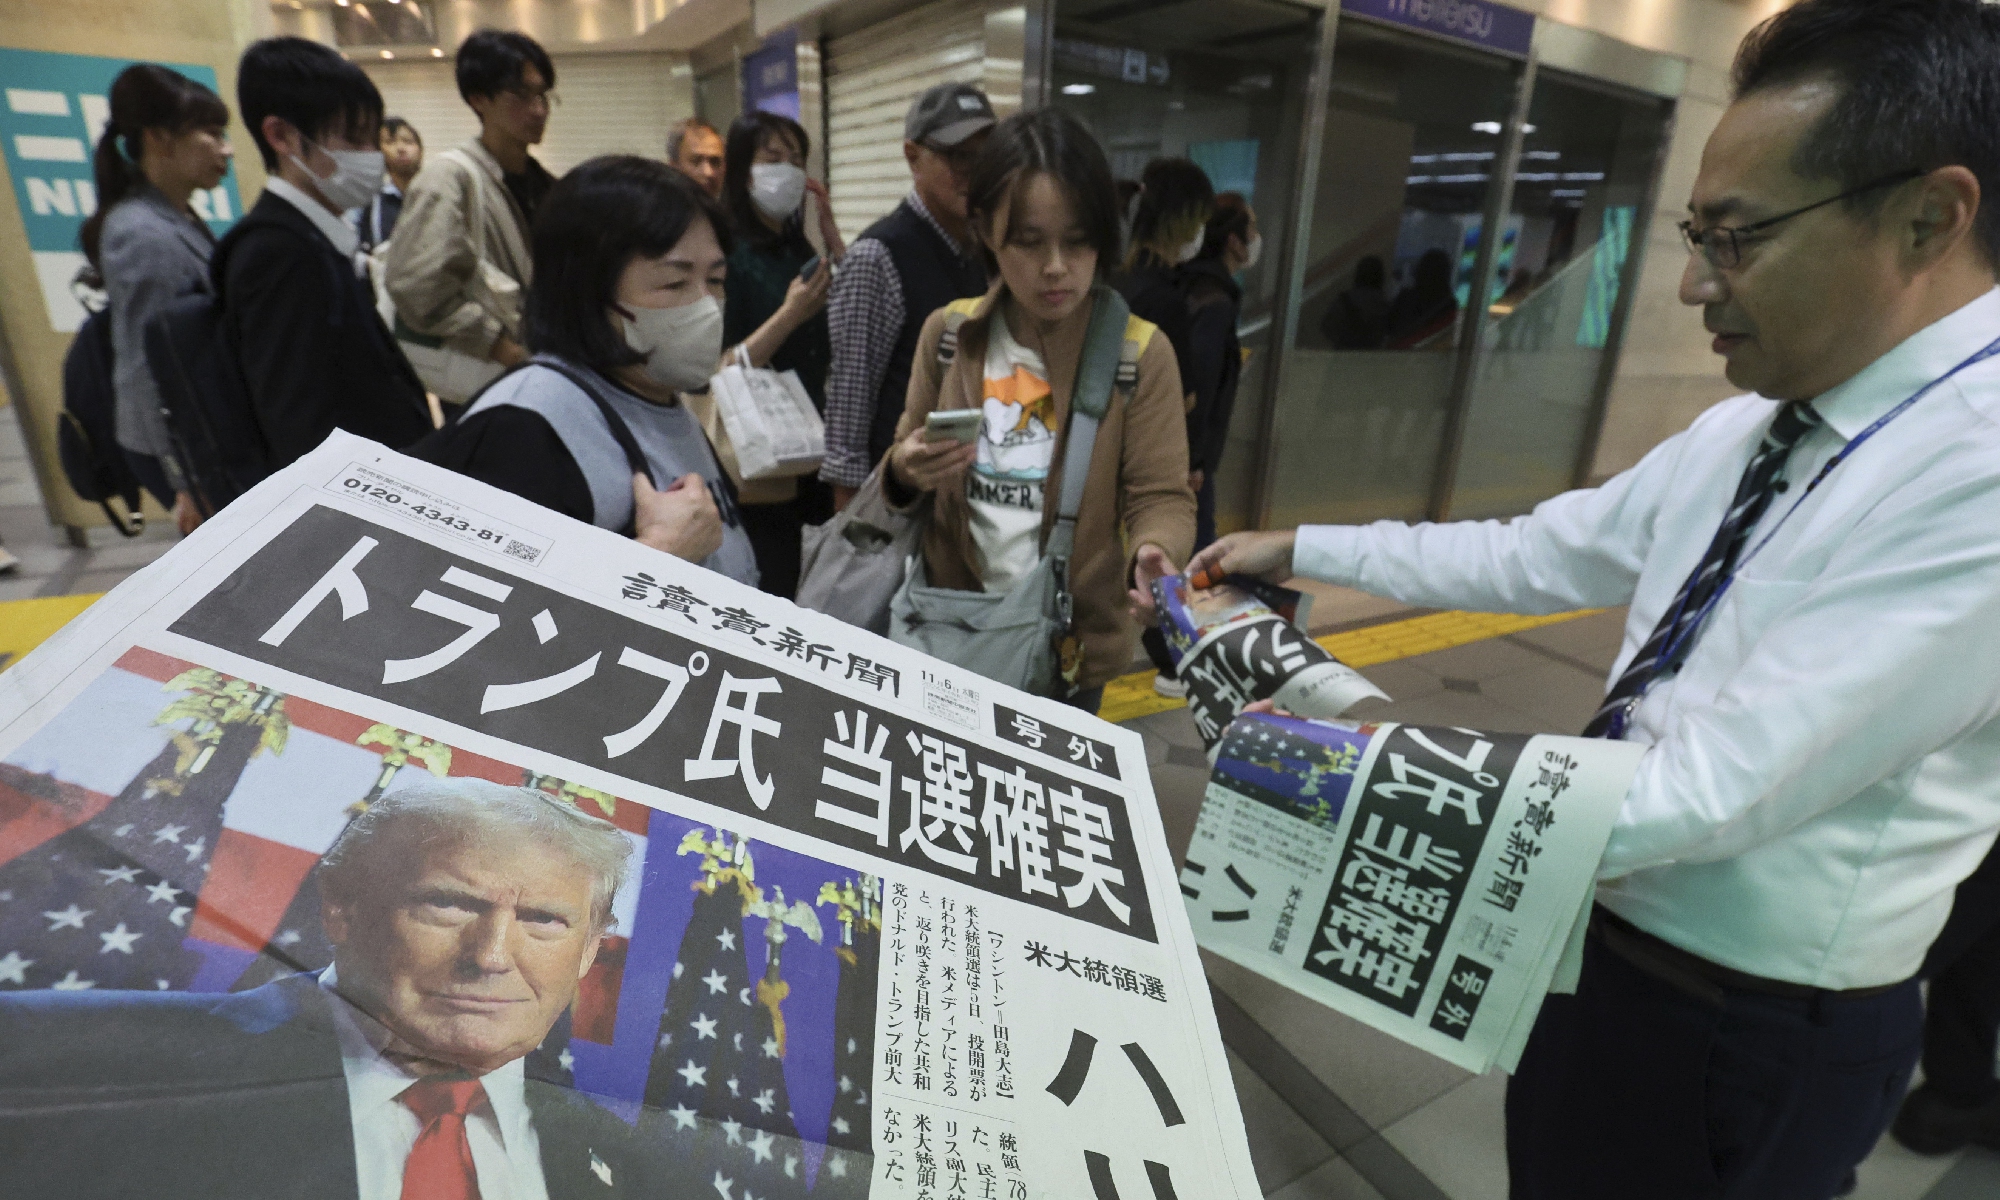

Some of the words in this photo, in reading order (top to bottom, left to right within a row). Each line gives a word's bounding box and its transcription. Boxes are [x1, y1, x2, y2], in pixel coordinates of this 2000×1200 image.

[343, 478, 504, 544] 0120-4343-81
[258, 534, 783, 811] トランプ氏
[814, 709, 1132, 926] 当選確実
[1010, 713, 1104, 772] 号外
[1313, 811, 1465, 1000] 当選確実
[1024, 940, 1168, 1003] 米大統領選
[1435, 970, 1486, 1030] 号外
[883, 1107, 906, 1190] なかった。
[944, 1120, 968, 1200] リス副大
